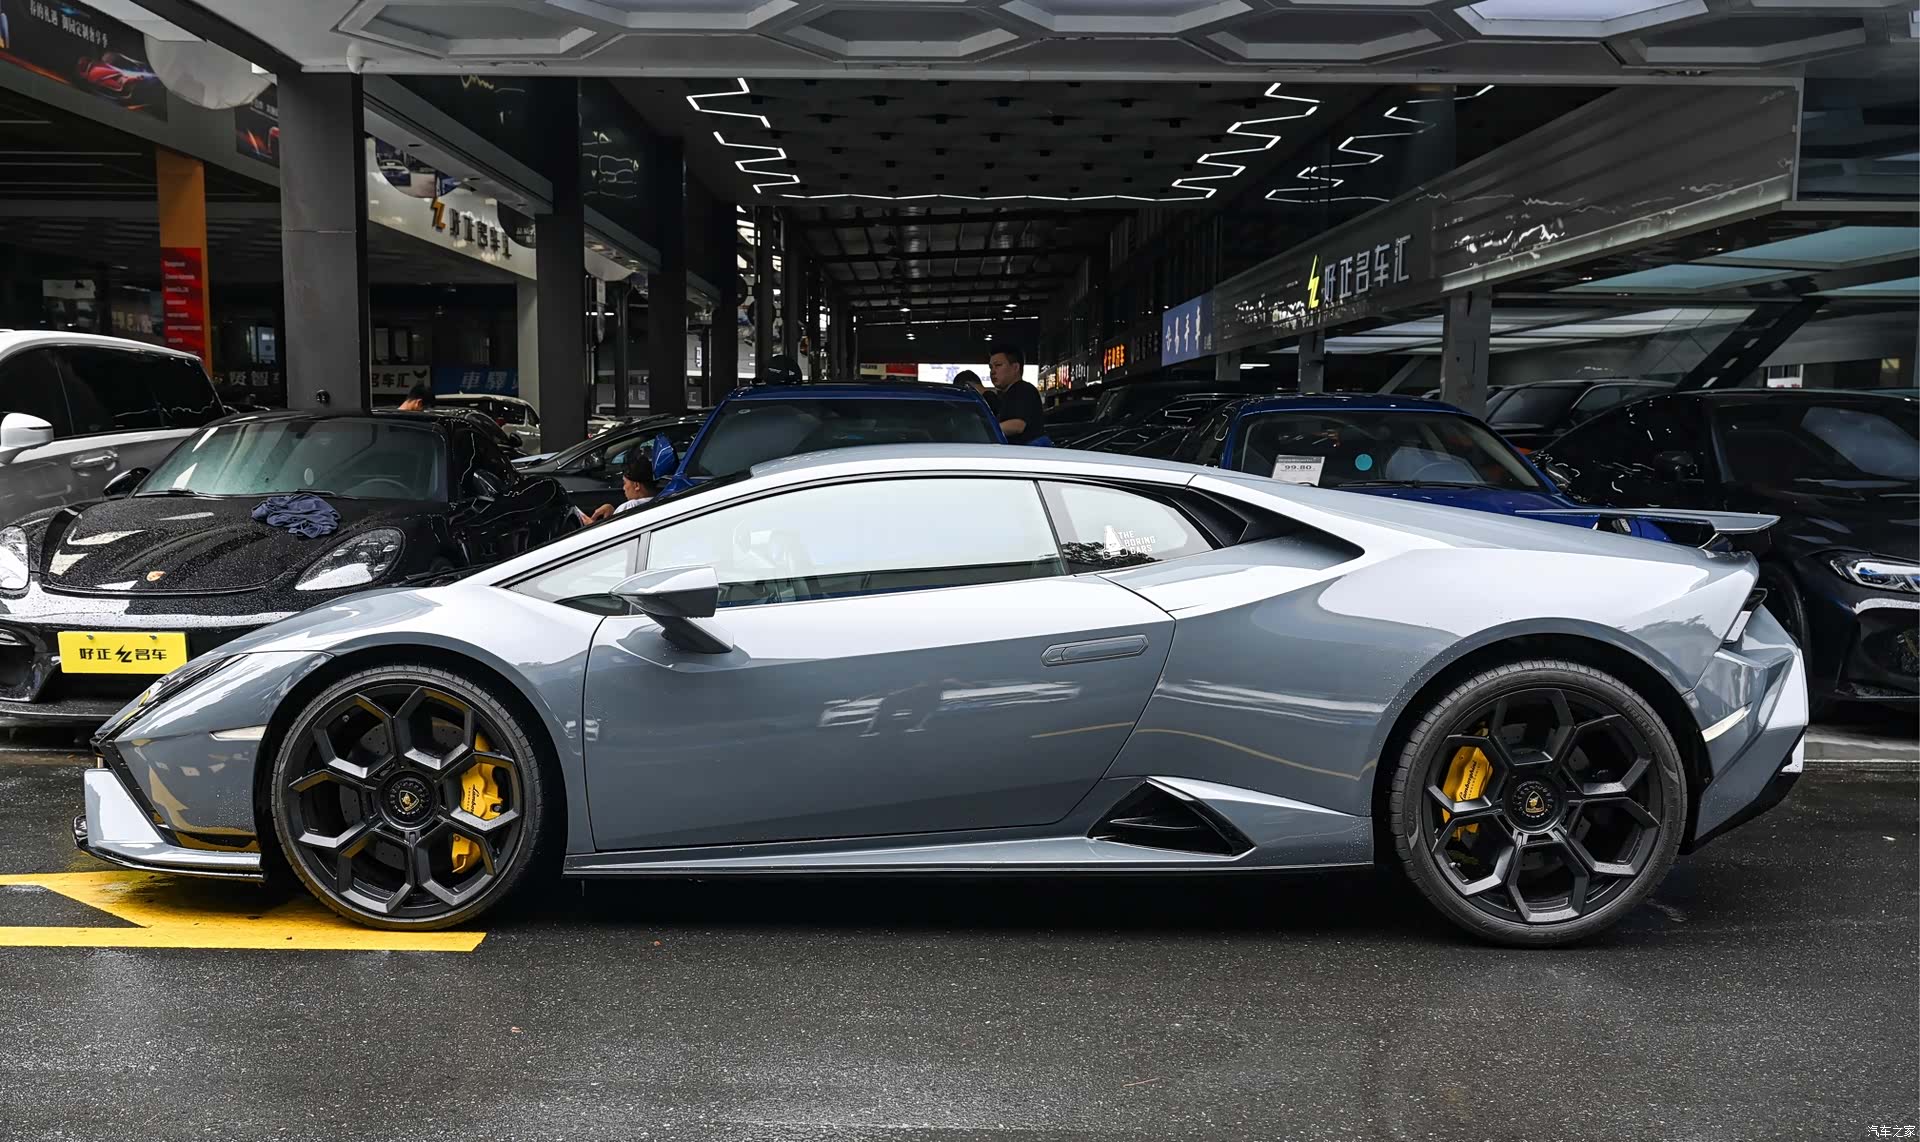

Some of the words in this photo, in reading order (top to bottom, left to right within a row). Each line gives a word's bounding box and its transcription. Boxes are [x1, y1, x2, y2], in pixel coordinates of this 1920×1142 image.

[1323, 234, 1411, 304] 好正名车汇
[459, 371, 518, 390] 車驛
[1118, 530, 1135, 540] THE
[1124, 535, 1156, 547] BORING
[1130, 544, 1153, 555] CARS
[79, 648, 112, 660] 好正
[135, 648, 167, 660] 名车
